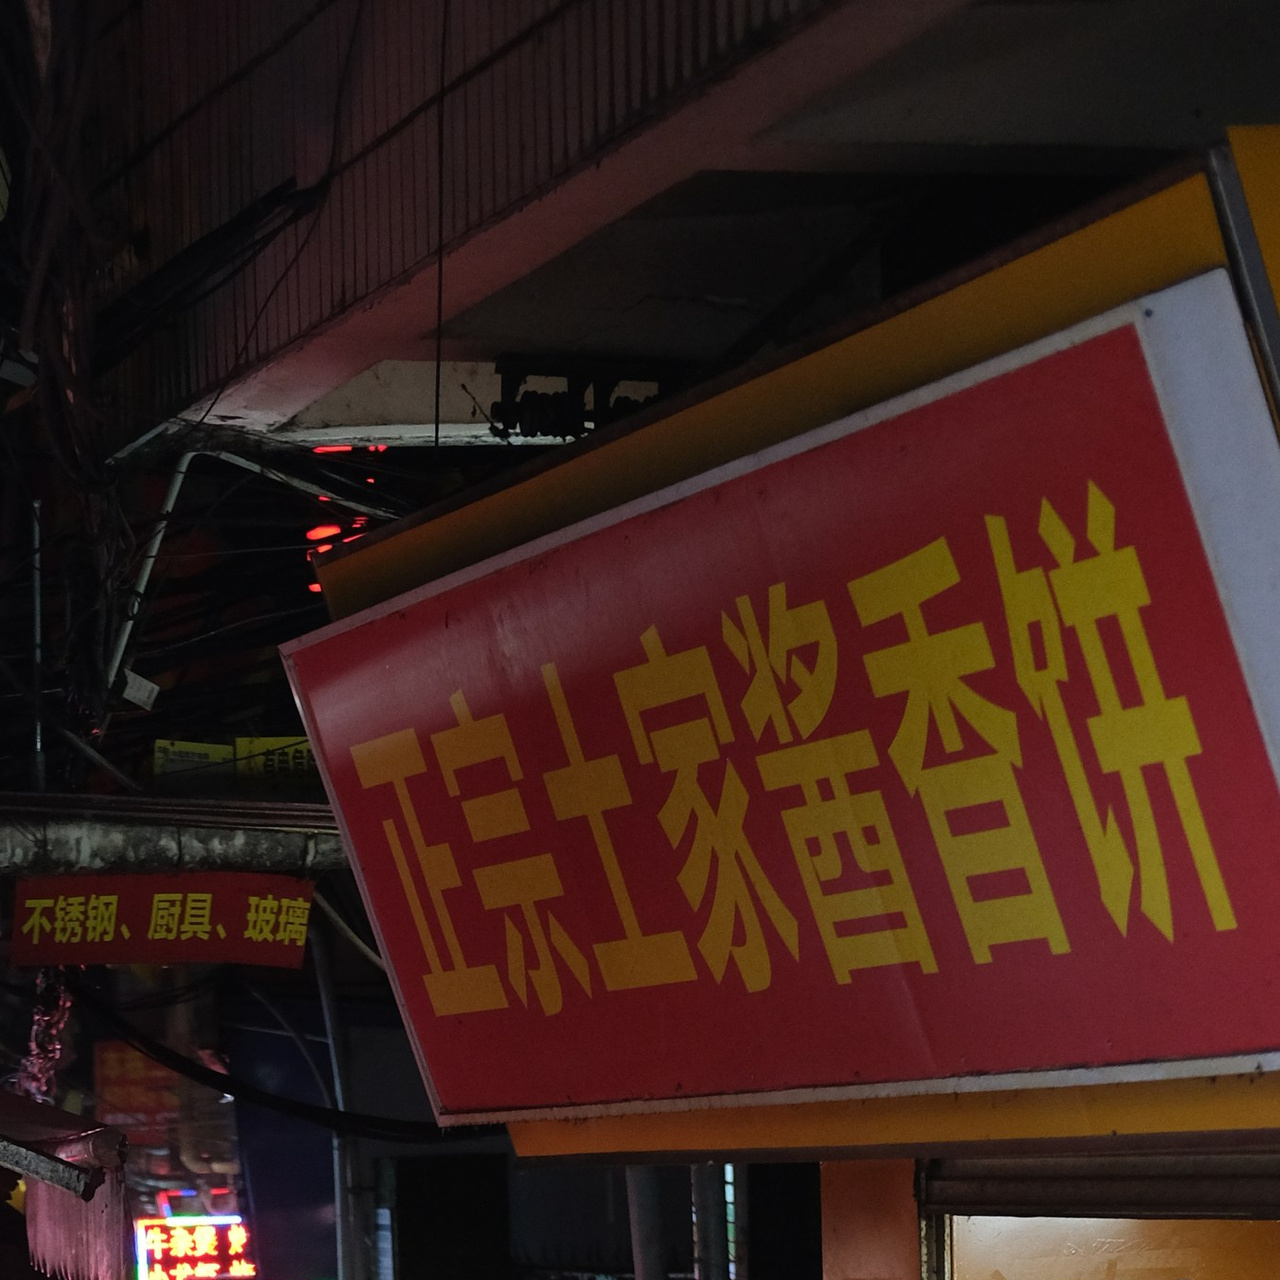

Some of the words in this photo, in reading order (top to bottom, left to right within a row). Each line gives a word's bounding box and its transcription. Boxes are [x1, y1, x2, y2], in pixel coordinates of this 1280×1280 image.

[352, 479, 1237, 1018] 正宗土家酱香饼
[22, 892, 310, 947] 不锈钢、厨具、玻璃
